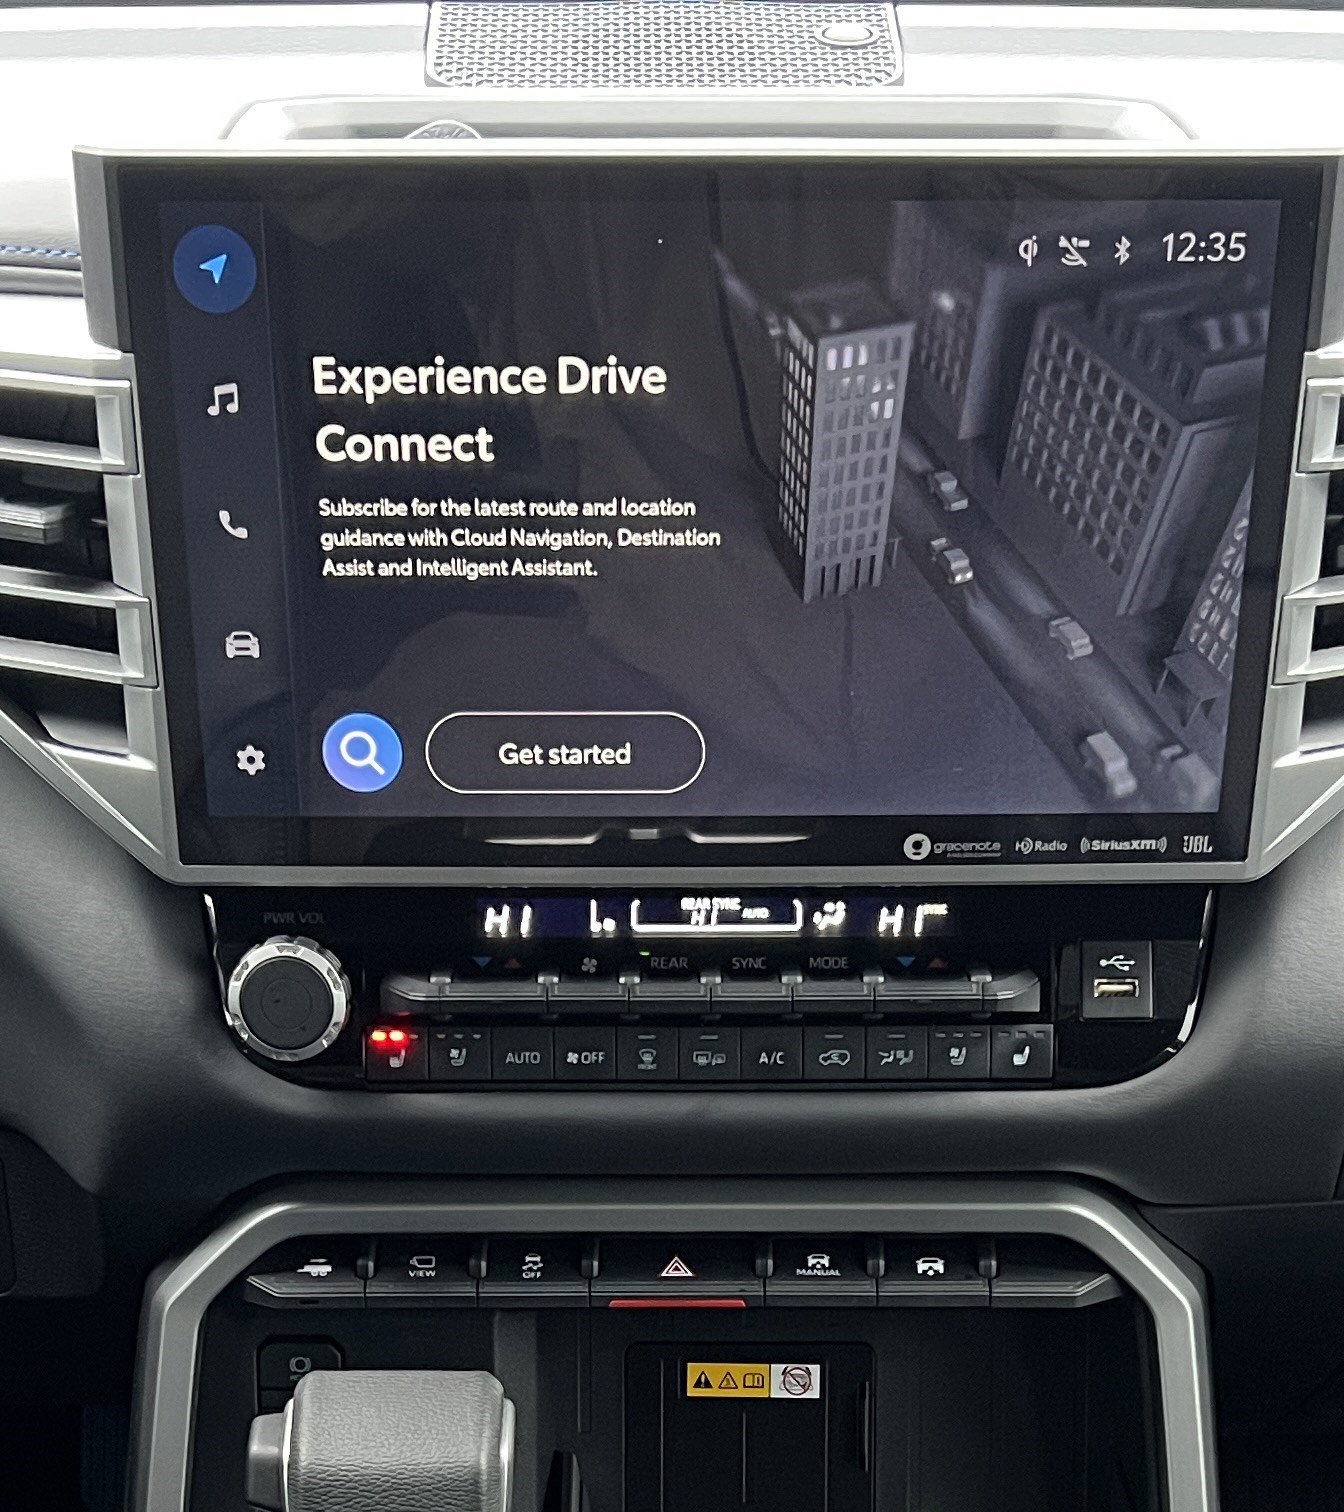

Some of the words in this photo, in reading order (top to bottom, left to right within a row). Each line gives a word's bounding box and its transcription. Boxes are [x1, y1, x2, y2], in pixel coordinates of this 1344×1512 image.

[1162, 232, 1247, 262] 12:35
[312, 356, 547, 404] Experience
[557, 356, 667, 395] Drive
[315, 424, 495, 462] Connect
[318, 498, 408, 517] Subscribe
[411, 498, 438, 517] for
[440, 498, 471, 517] the
[474, 498, 526, 517] latest
[529, 499, 578, 517] route
[582, 498, 617, 517] and
[621, 498, 696, 517] location
[320, 528, 406, 551] guidance
[409, 528, 448, 547] with
[451, 528, 506, 547] Cloud
[510, 528, 613, 551] Navigation,
[617, 528, 721, 547] Destination
[322, 558, 375, 577] Assist
[378, 558, 413, 577] and
[416, 558, 509, 580] Intelligent
[511, 558, 598, 577] Assistant.
[498, 742, 544, 765] Get
[548, 742, 631, 765] started
[934, 842, 1001, 853] gracenote
[1035, 840, 1068, 851] Radio
[1183, 836, 1213, 853] JBL
[650, 957, 688, 969] REAR
[732, 957, 767, 970] SYNC
[809, 957, 848, 969] MODE
[506, 1052, 541, 1064] AUTO
[581, 1052, 605, 1064] OFF
[758, 1052, 785, 1065] A/C
[409, 1270, 436, 1278] VIEW
[522, 1271, 541, 1279] OFF
